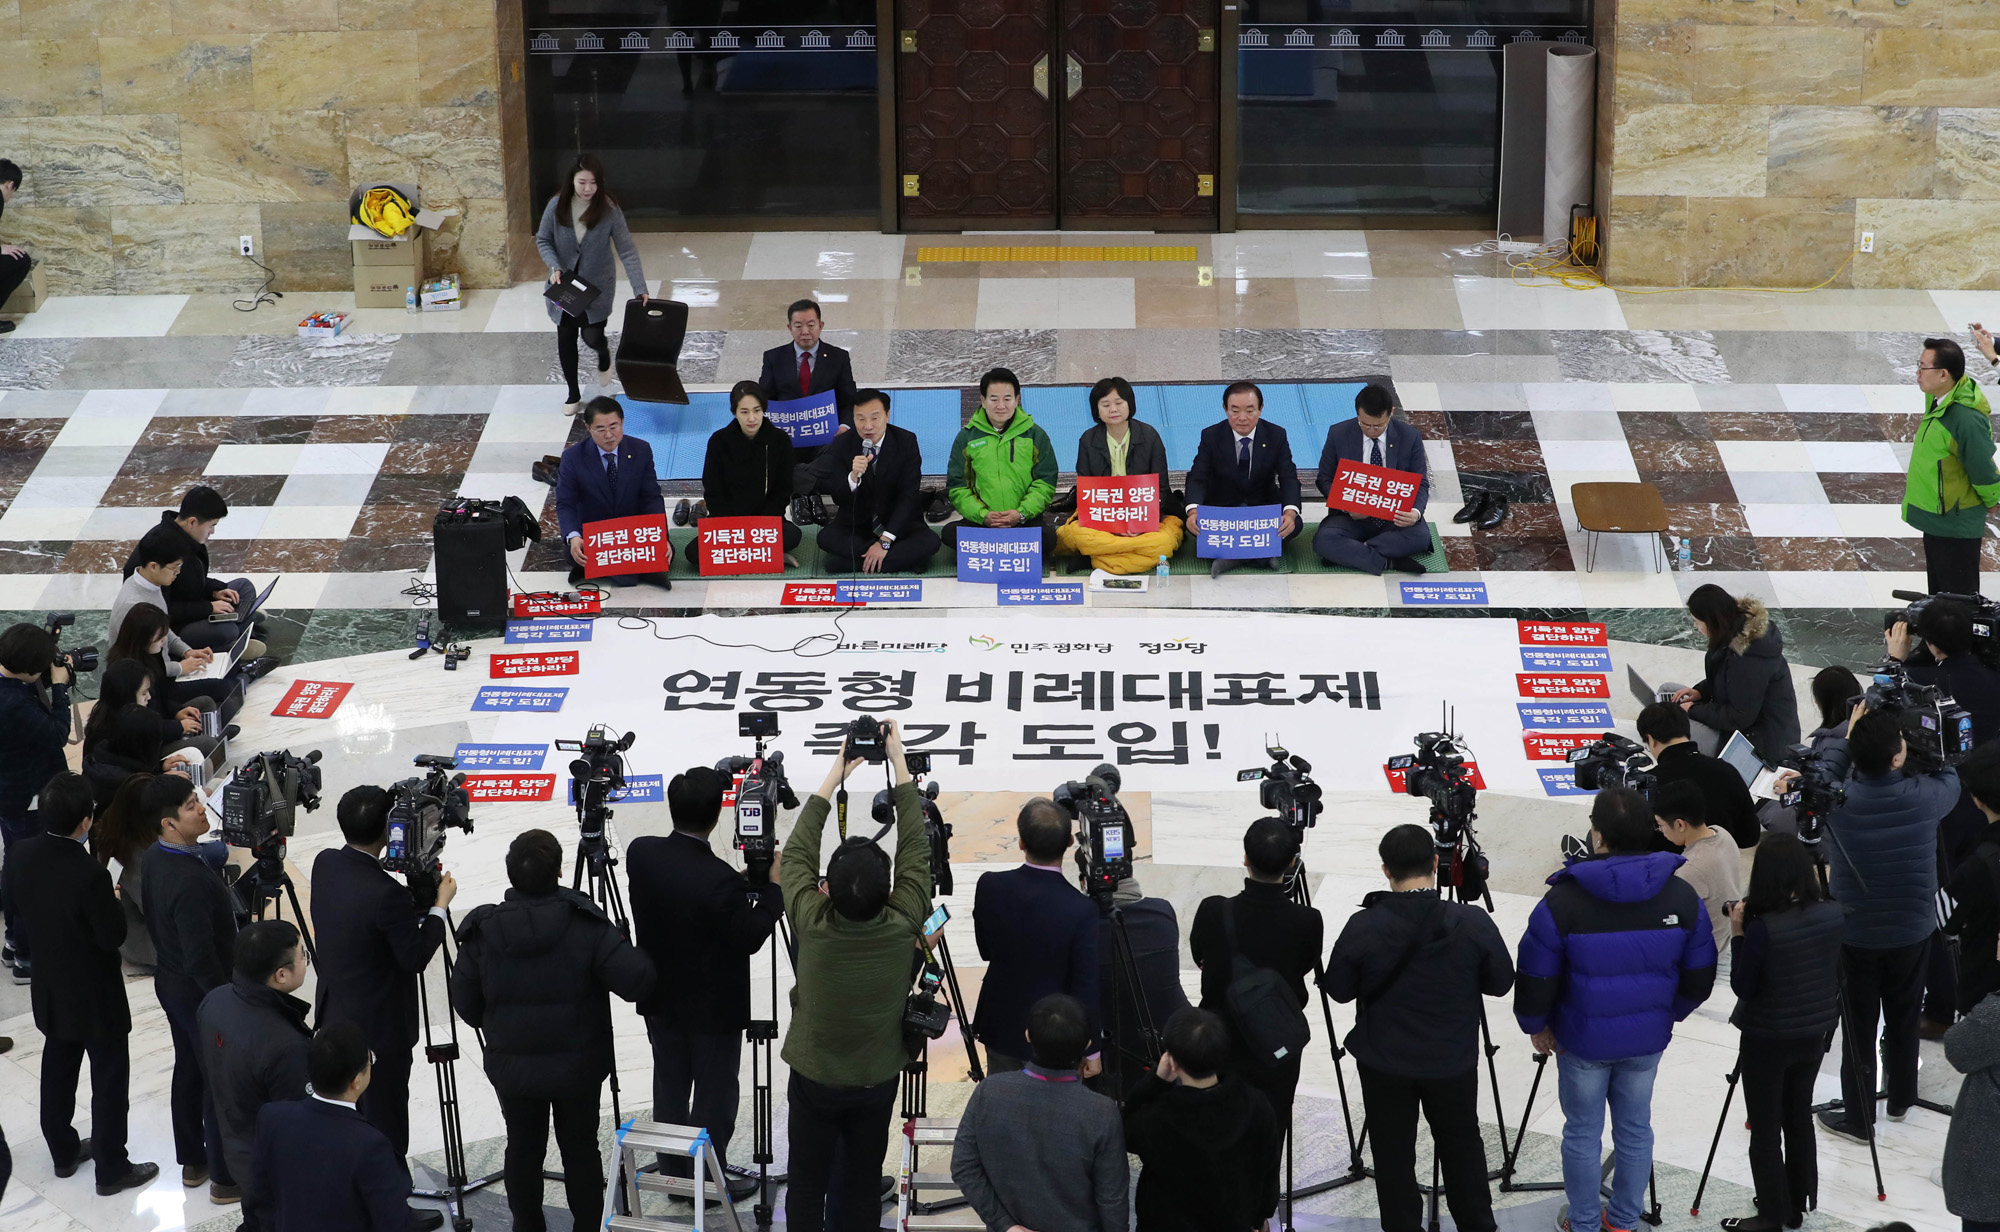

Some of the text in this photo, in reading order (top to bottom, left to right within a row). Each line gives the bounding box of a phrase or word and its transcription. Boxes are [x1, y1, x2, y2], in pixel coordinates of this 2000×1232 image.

[800, 420, 829, 437] 도입!
[1339, 470, 1415, 498] 기득권 양당
[1082, 486, 1156, 503] 기득권 양당
[1342, 487, 1403, 513] 결단하라!
[1088, 506, 1148, 522] 결단하라!
[1199, 517, 1279, 532] 연동형비례대표제
[588, 526, 663, 548] 기득권 양당
[703, 528, 779, 545] 기득권 양당
[1206, 533, 1270, 549] 즉각 도입!
[959, 540, 1040, 555] 연동형비례대표제
[595, 545, 656, 566] 결단하라!
[710, 547, 772, 564] 결단하라!
[967, 557, 1031, 573] 즉각 도입!
[789, 587, 832, 595] 기득권
[838, 584, 920, 592] 연동형비례대표제
[999, 587, 1081, 595] 연동형비례대표제
[877, 590, 910, 598] 도입!
[1008, 593, 1072, 602] 즉각 도입!
[1412, 593, 1477, 601] 즉각 도입!
[527, 602, 588, 613] 결단하라!
[508, 623, 591, 632] 연동형비례대표제
[1523, 625, 1601, 635] 기득권 양당
[515, 630, 581, 639] 즉각 도입!
[1531, 633, 1594, 642] 결단하라!
[837, 640, 948, 654] 바른미래당
[1010, 641, 1114, 654] 민주평화당
[1139, 640, 1208, 655] 정의당
[495, 654, 575, 667] 기득권 양당
[1523, 652, 1607, 660] 연동형비례대표제
[1533, 659, 1600, 667] 즉각 도입!
[502, 663, 567, 674] 결단하라!
[1522, 678, 1602, 686] 기득권 양당
[480, 690, 565, 699] 연동형비례대표제
[662, 669, 1382, 713] 연동형 비례대표제
[1531, 686, 1597, 694] 결단하라!
[286, 696, 312, 716] 기득권
[484, 697, 552, 707] 즉각 도입!
[1520, 707, 1608, 716] 연동형비례대표제
[1532, 715, 1601, 724] 즉각 도입!
[1012, 720, 1222, 765] 도입!
[1529, 738, 1575, 747] 기득권
[457, 748, 545, 758] 연동형비례대표제
[462, 756, 532, 766] 즉각 도입!
[466, 778, 551, 788] 기득권 양당
[472, 788, 540, 798] 결단하라!
[614, 788, 651, 798] 도입!
[740, 807, 761, 817] TJB
